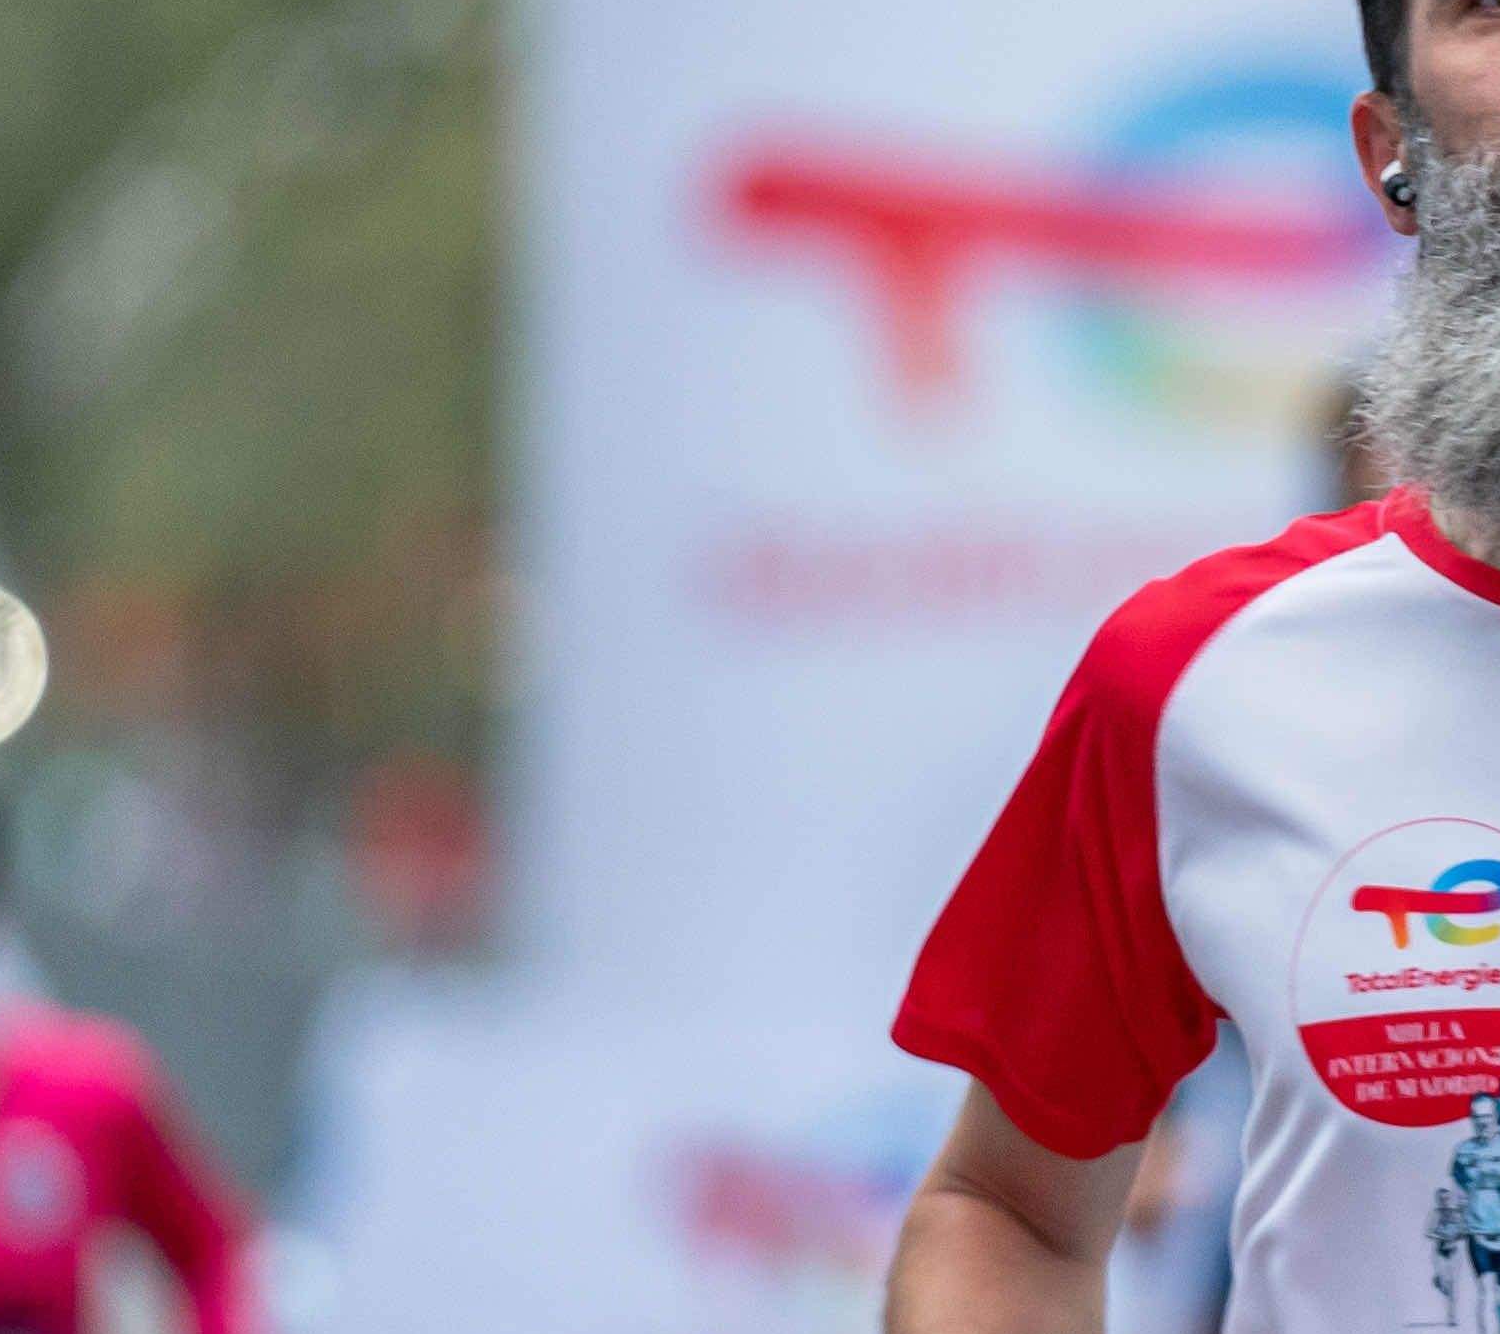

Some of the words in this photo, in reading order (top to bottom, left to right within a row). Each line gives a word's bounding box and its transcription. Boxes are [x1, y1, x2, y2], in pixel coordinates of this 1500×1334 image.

[1385, 1021, 1467, 1043] MILLA
[1355, 1080, 1392, 1102] DE
[1396, 1073, 1500, 1100] MADRID
